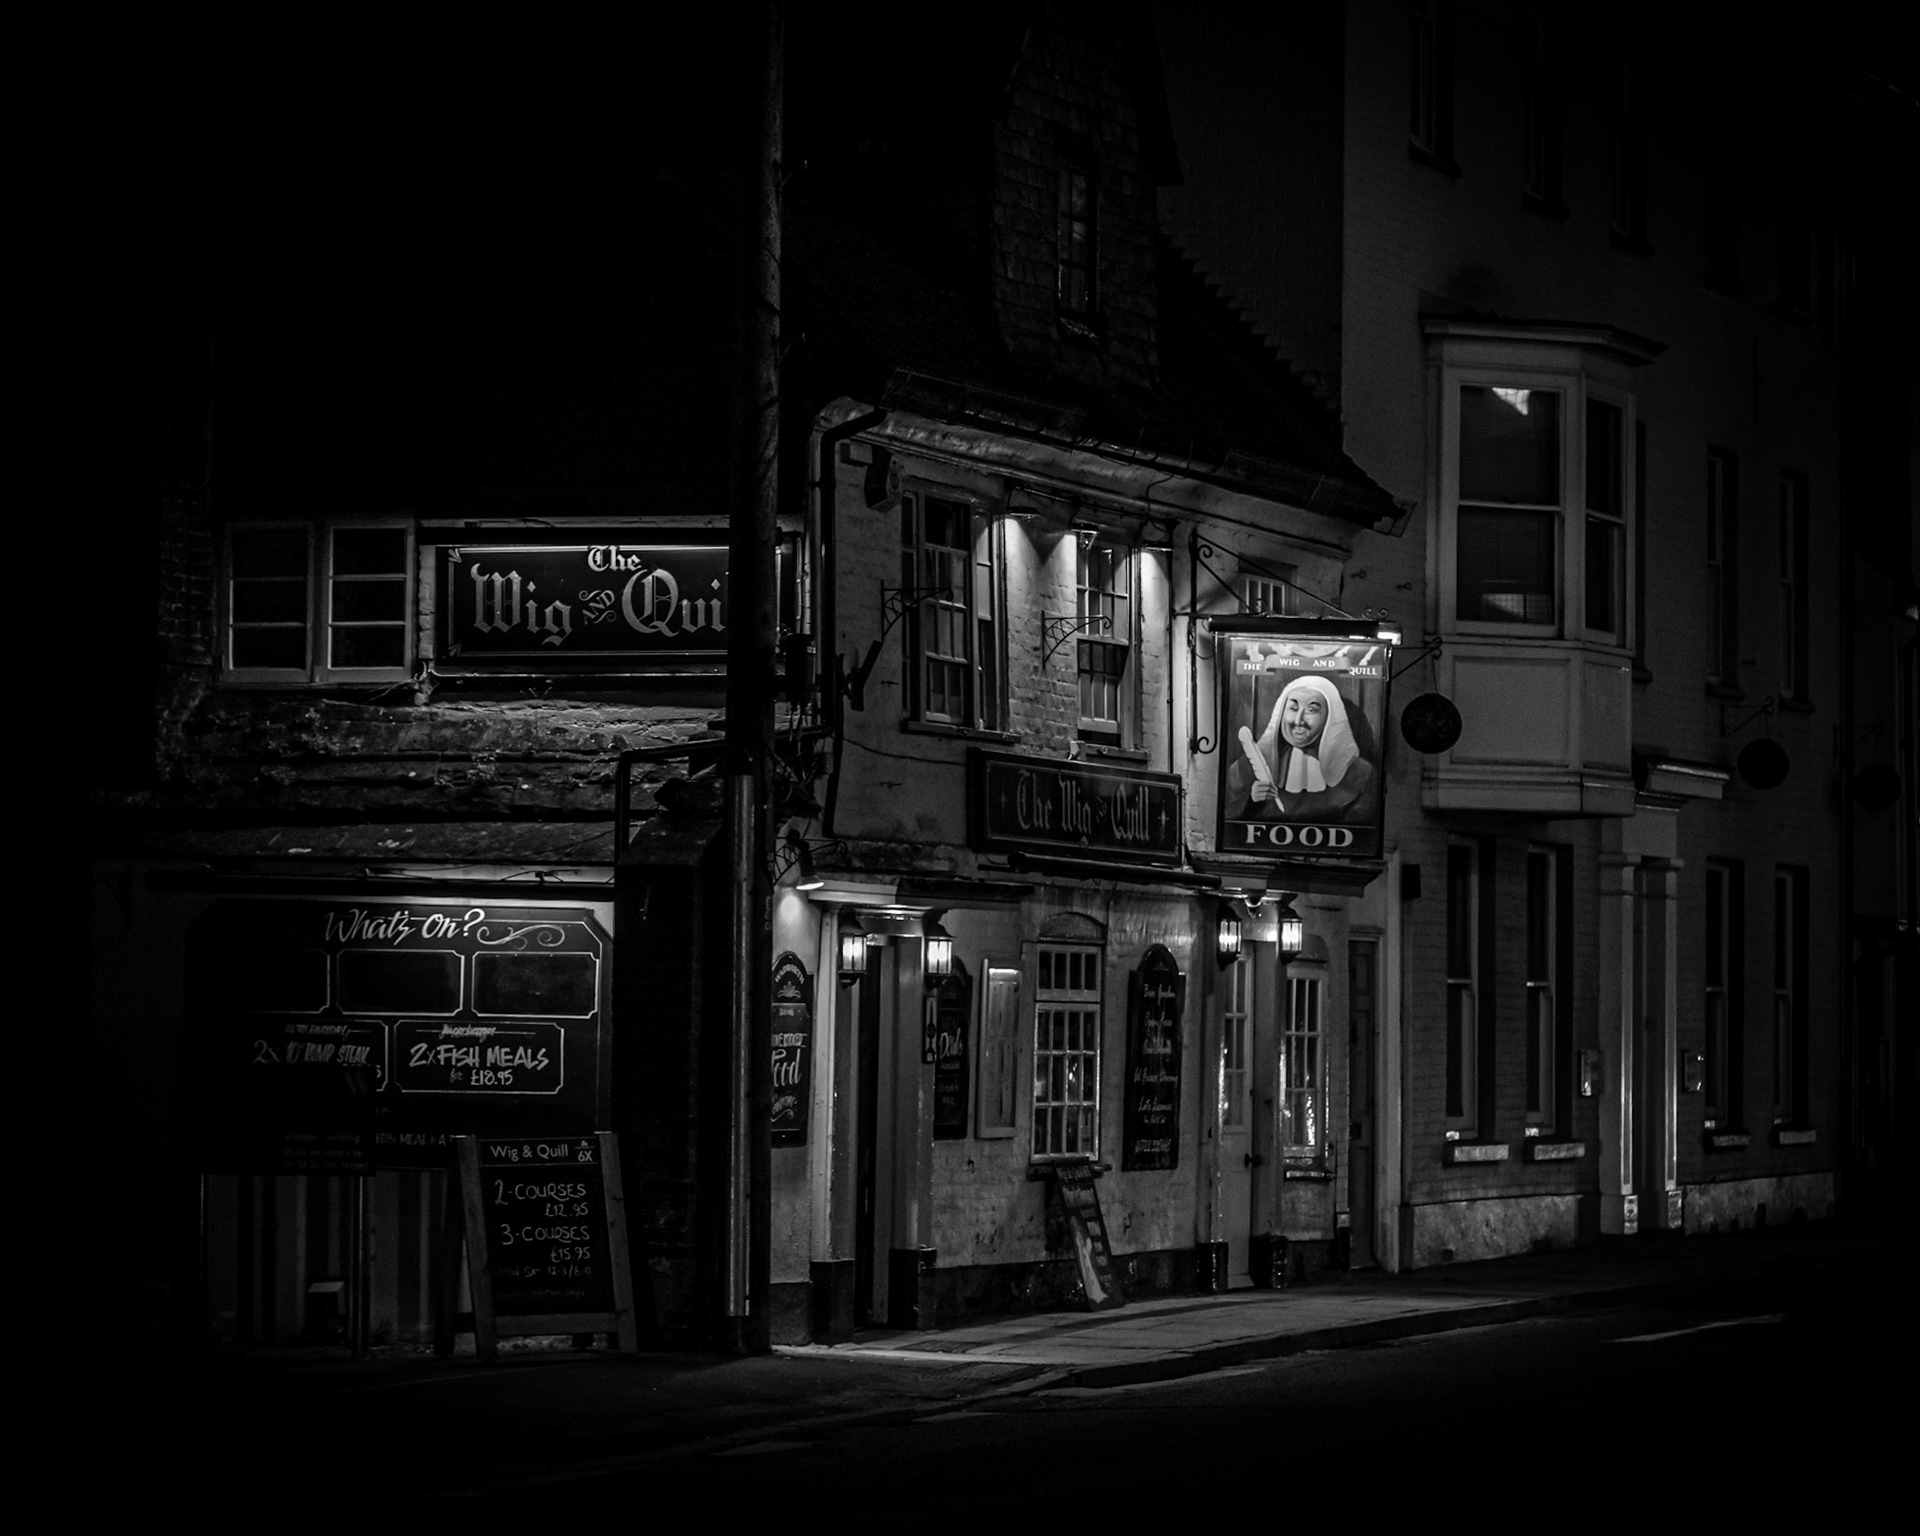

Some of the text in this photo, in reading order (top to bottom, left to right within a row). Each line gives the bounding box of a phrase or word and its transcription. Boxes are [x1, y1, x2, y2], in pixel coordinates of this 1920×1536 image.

[587, 545, 642, 572] The
[470, 562, 573, 647] Wig
[621, 567, 728, 638] Qui
[1242, 657, 1378, 676] THE WIG AND QUILL
[1016, 769, 1053, 830] The
[1057, 771, 1092, 836] Wig
[1110, 782, 1151, 841] Quill
[1245, 823, 1354, 848] FOOD
[421, 907, 486, 940] On?
[485, 1045, 550, 1071] MEALS
[470, 1068, 514, 1087] £18.95
[490, 1143, 594, 1162] Wig & Quill 6X
[544, 1201, 589, 1217] £12.95
